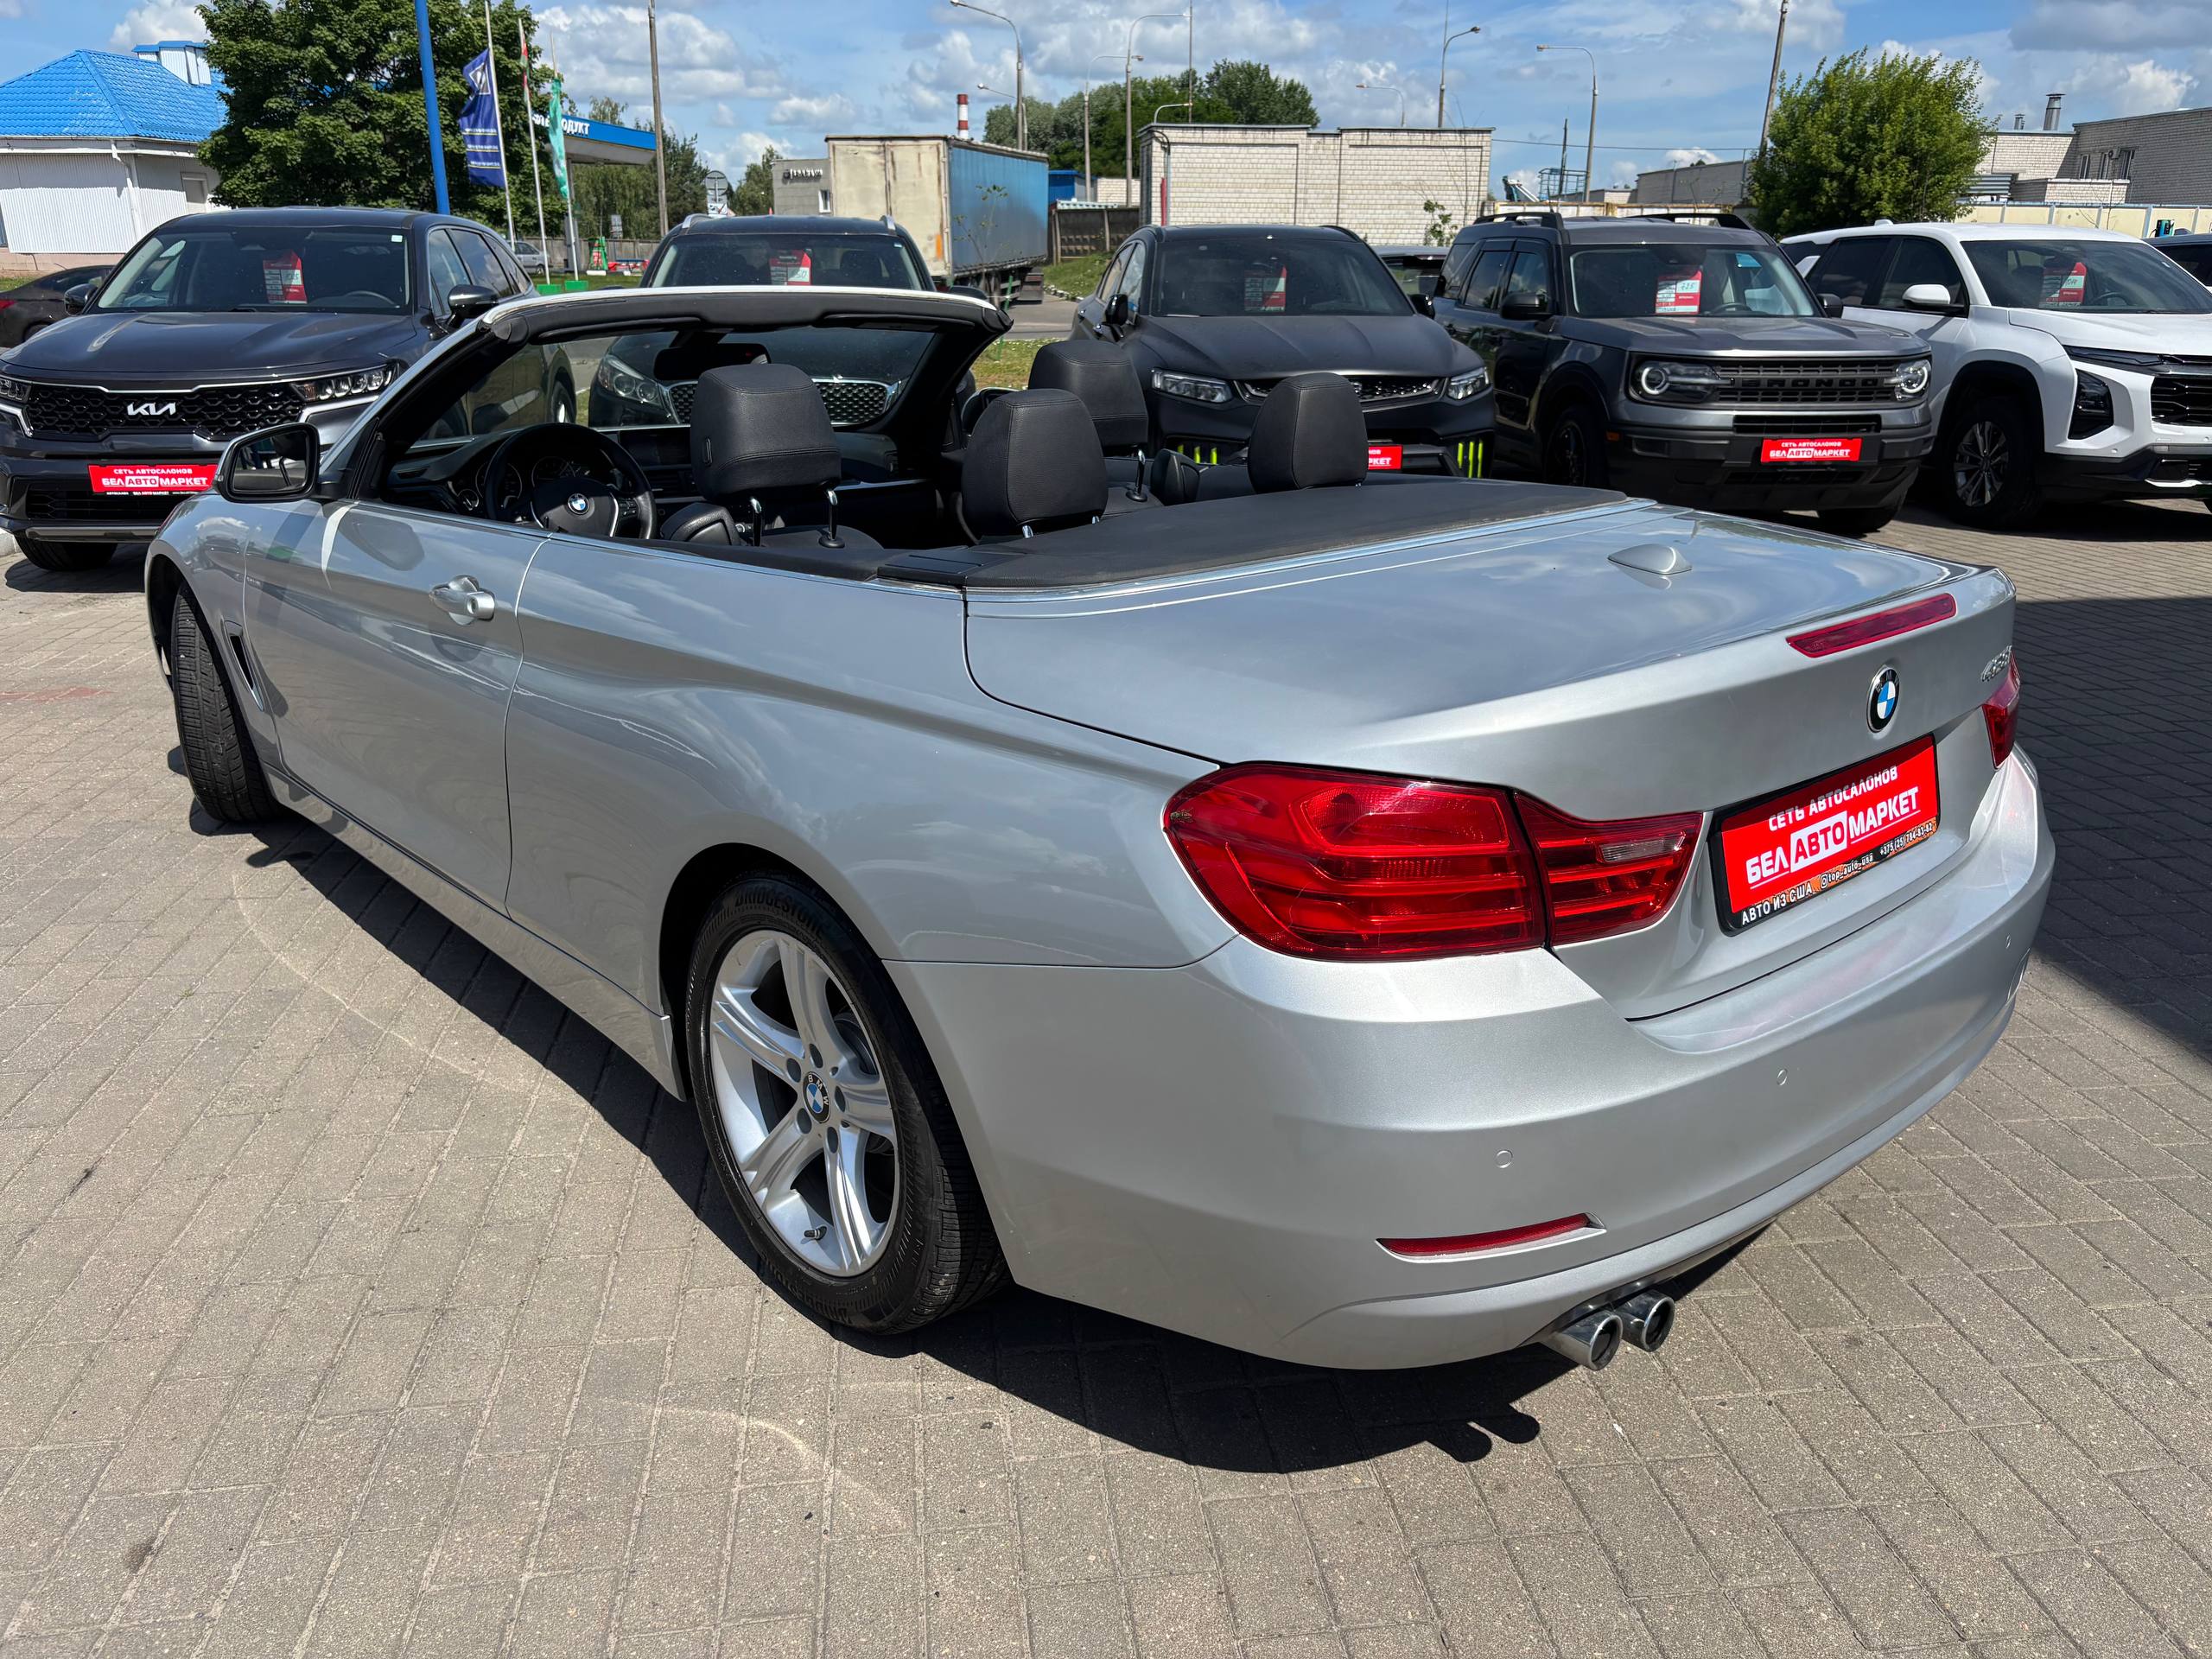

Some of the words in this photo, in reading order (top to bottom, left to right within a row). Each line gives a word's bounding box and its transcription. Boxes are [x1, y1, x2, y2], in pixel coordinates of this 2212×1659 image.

[127, 402, 176, 416] KIA
[1769, 805, 1805, 831] СЕТЬ
[1808, 766, 1898, 816] АВТОСАЛОНОВ
[1742, 901, 1770, 925] АВТО
[1773, 893, 1787, 911] ИЗ
[1789, 881, 1813, 902] США
[808, 1074, 829, 1105] BMW
